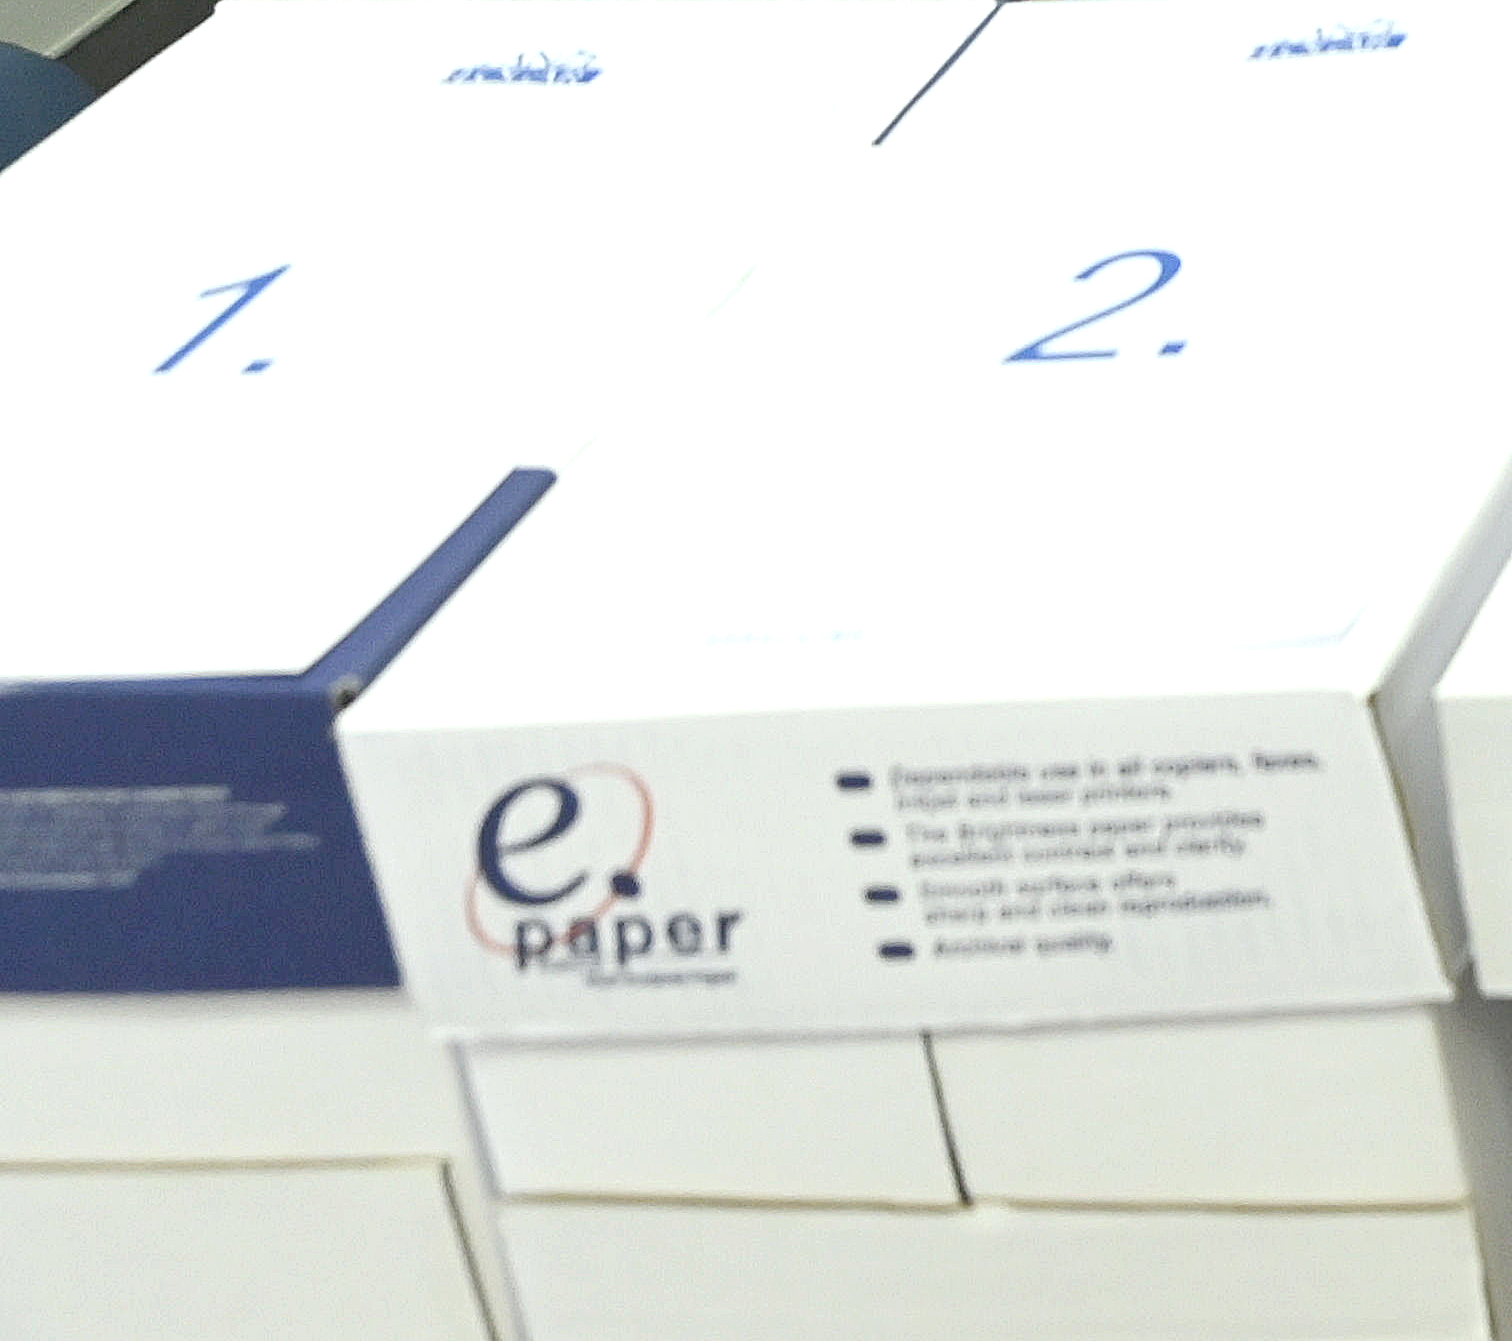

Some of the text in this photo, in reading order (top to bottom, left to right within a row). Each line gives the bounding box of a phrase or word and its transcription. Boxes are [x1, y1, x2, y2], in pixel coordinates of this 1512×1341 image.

[154, 265, 290, 375] 1.
[1006, 248, 1189, 364] 2.
[512, 909, 743, 975] paper
